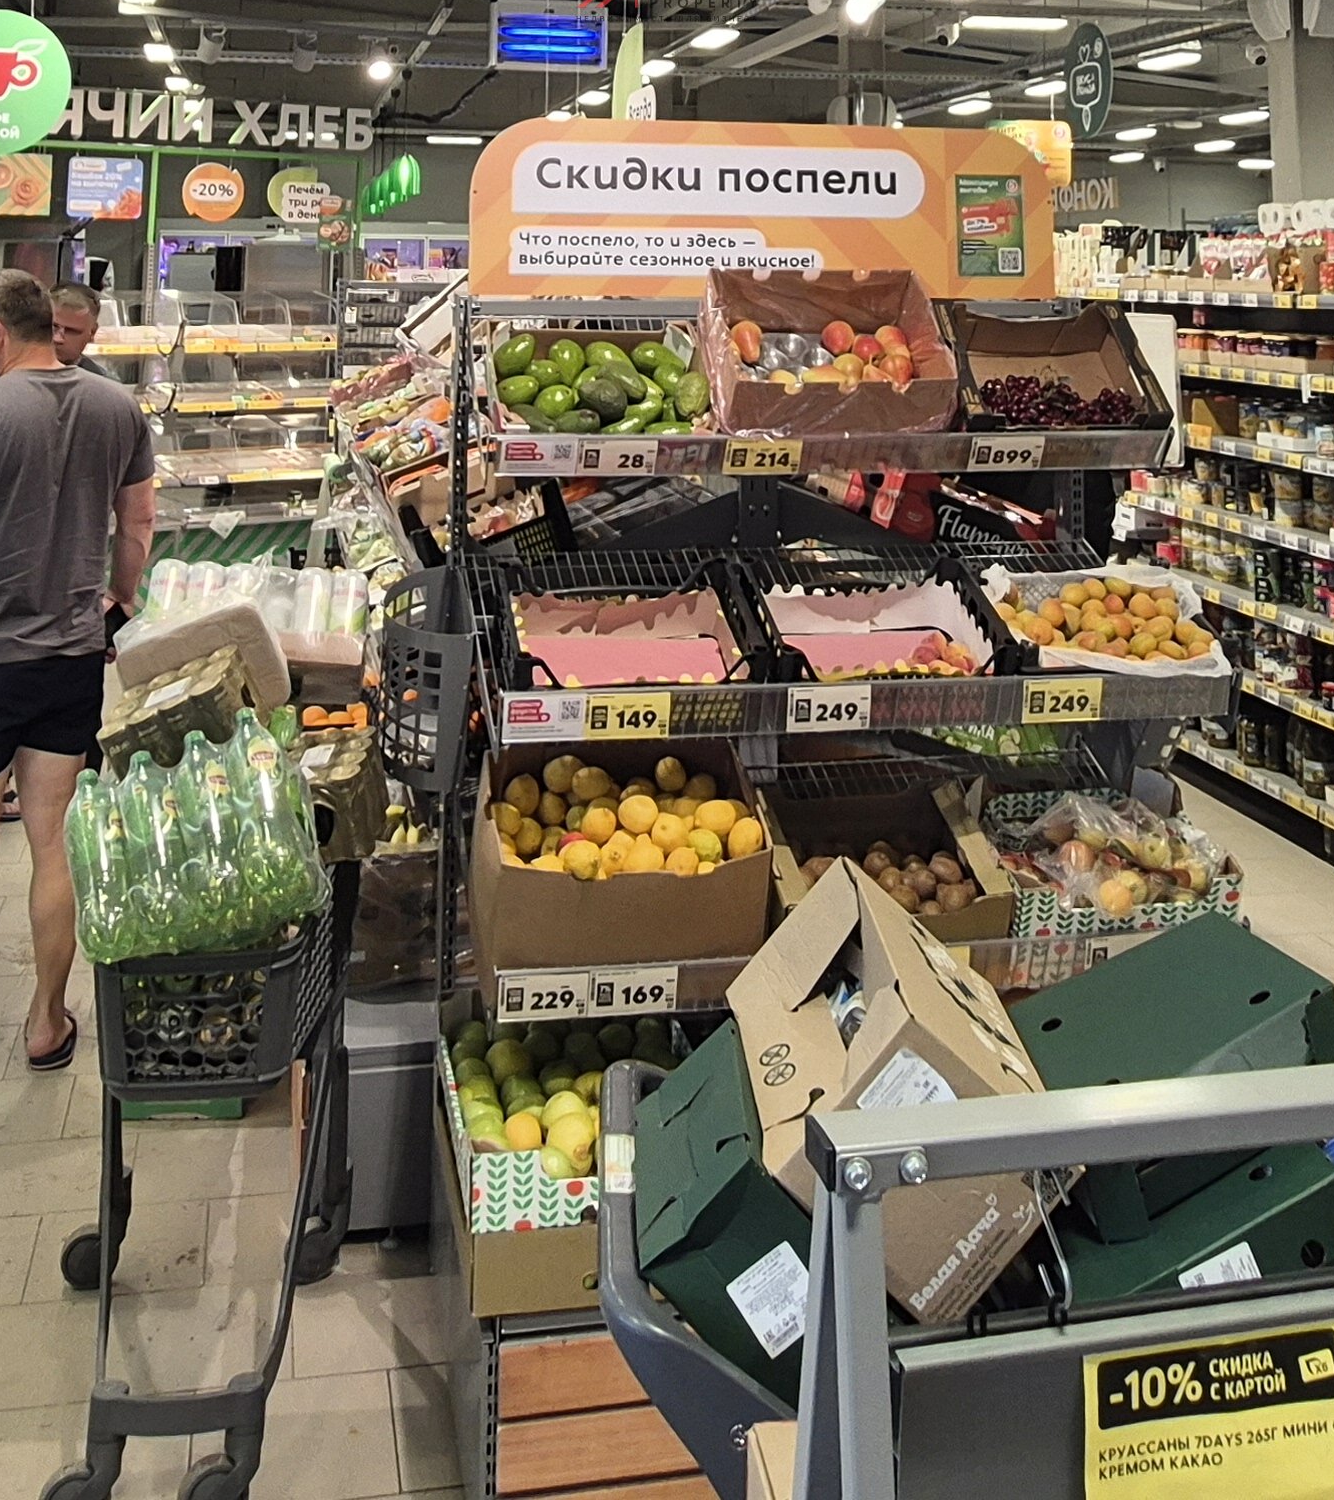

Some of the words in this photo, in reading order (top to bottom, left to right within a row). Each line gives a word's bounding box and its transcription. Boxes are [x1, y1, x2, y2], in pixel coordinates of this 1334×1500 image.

[228, 99, 374, 151] ХЛЕБ
[536, 156, 702, 192] Скидки
[719, 165, 898, 197] поспели
[192, 182, 235, 198] -20%
[288, 184, 324, 196] Печём
[288, 197, 307, 209] три
[288, 210, 295, 219] в
[519, 232, 552, 247] Что
[558, 233, 639, 250] поспело,
[644, 235, 665, 248] то
[671, 236, 680, 248] и
[687, 233, 736, 249] здесь
[519, 249, 624, 271] выбирайте
[629, 253, 715, 268] сезонное
[721, 254, 731, 268] и
[737, 254, 816, 269] вкусное!
[617, 453, 644, 469] 28
[753, 451, 791, 468] 214
[991, 450, 1032, 465] 899
[816, 703, 859, 721] 249
[1048, 695, 1090, 713] 249
[616, 709, 657, 729] 149
[530, 990, 575, 1011] 229
[621, 985, 665, 1005] 169
[908, 1253, 962, 1311] Белая
[955, 1206, 1001, 1259] Дача
[1208, 1350, 1274, 1377] СКИДКА
[1109, 1361, 1203, 1411] -10%
[1209, 1383, 1221, 1400] С
[1224, 1369, 1287, 1400] КАРТОЙ
[1098, 1435, 1190, 1464] КРУАССАНЫ
[1194, 1431, 1243, 1449] 7DAYS
[1247, 1427, 1277, 1445] 265Г
[1282, 1420, 1328, 1440] МИНИ
[1098, 1460, 1165, 1481] КРЕМОМ
[1170, 1452, 1224, 1469] КАКАО
